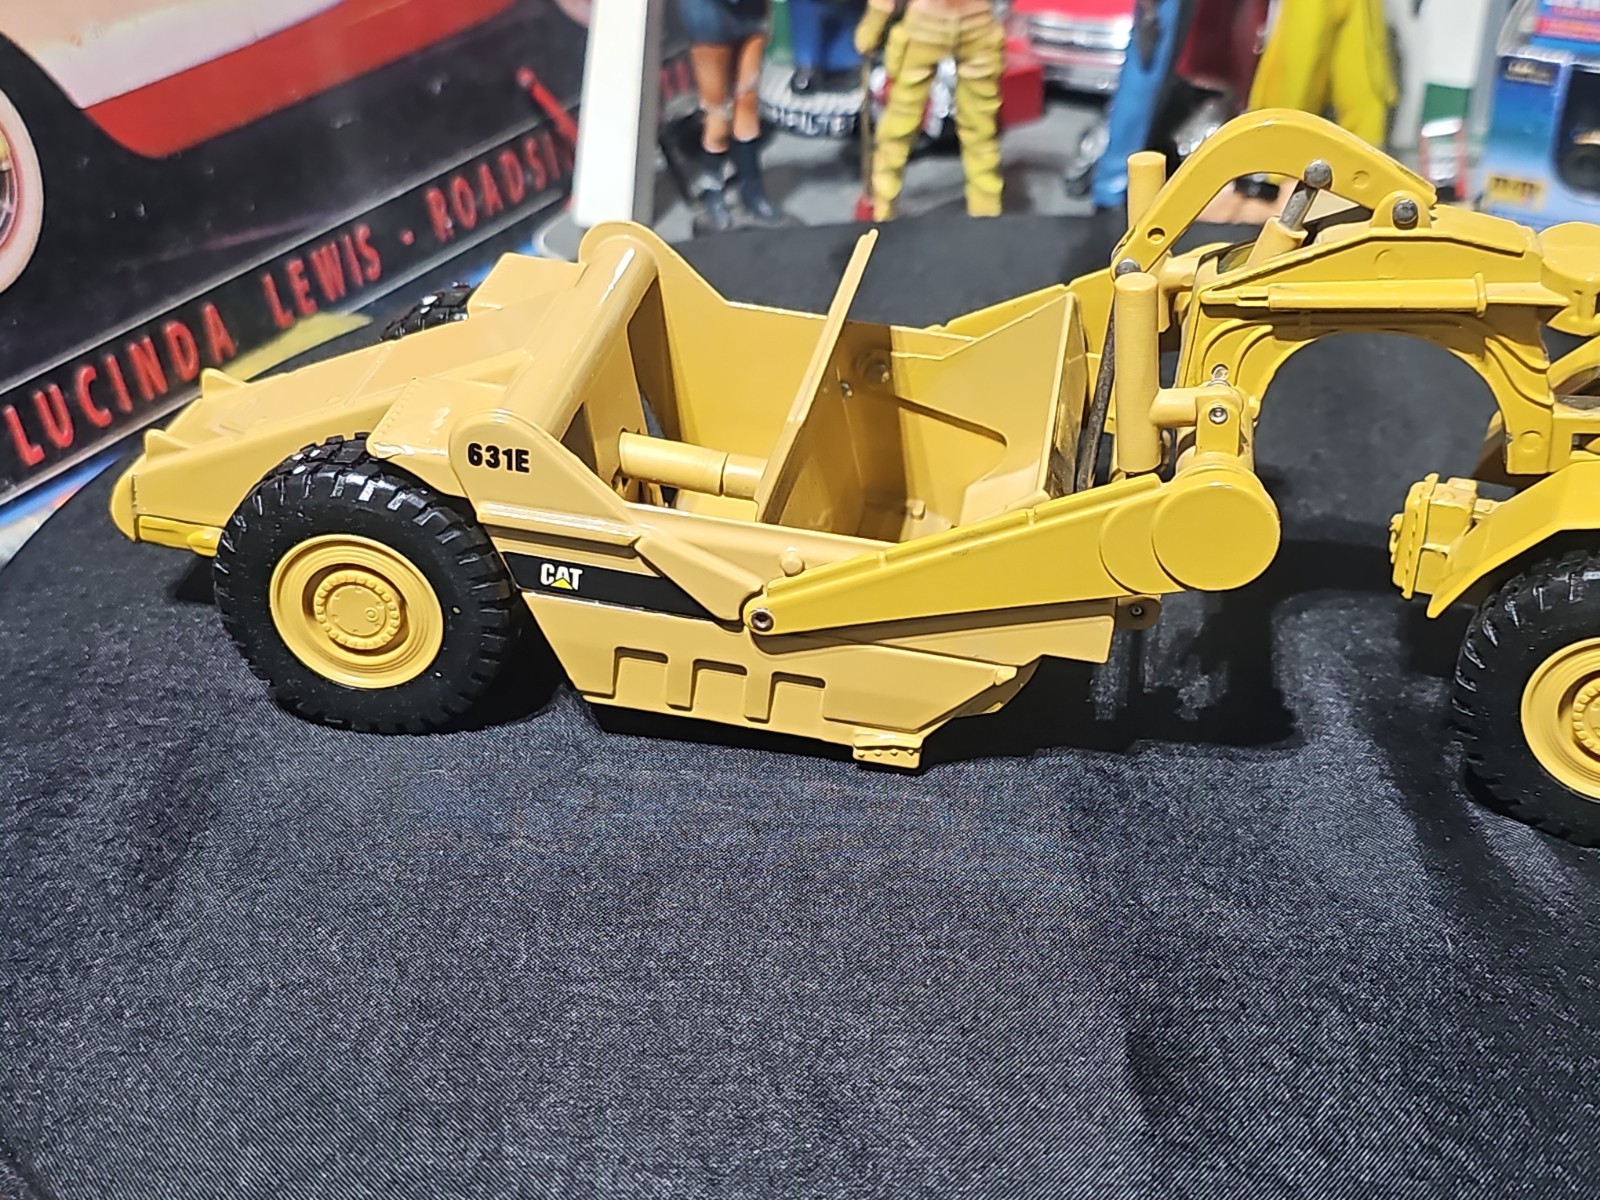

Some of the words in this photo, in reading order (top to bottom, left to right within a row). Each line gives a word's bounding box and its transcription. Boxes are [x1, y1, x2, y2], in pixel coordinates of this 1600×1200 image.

[3, 303, 237, 466] LUCINDA
[261, 223, 384, 331] LEWIS
[425, 129, 574, 243] ROADSI
[467, 443, 530, 474] 631E
[540, 563, 583, 591] CAT
